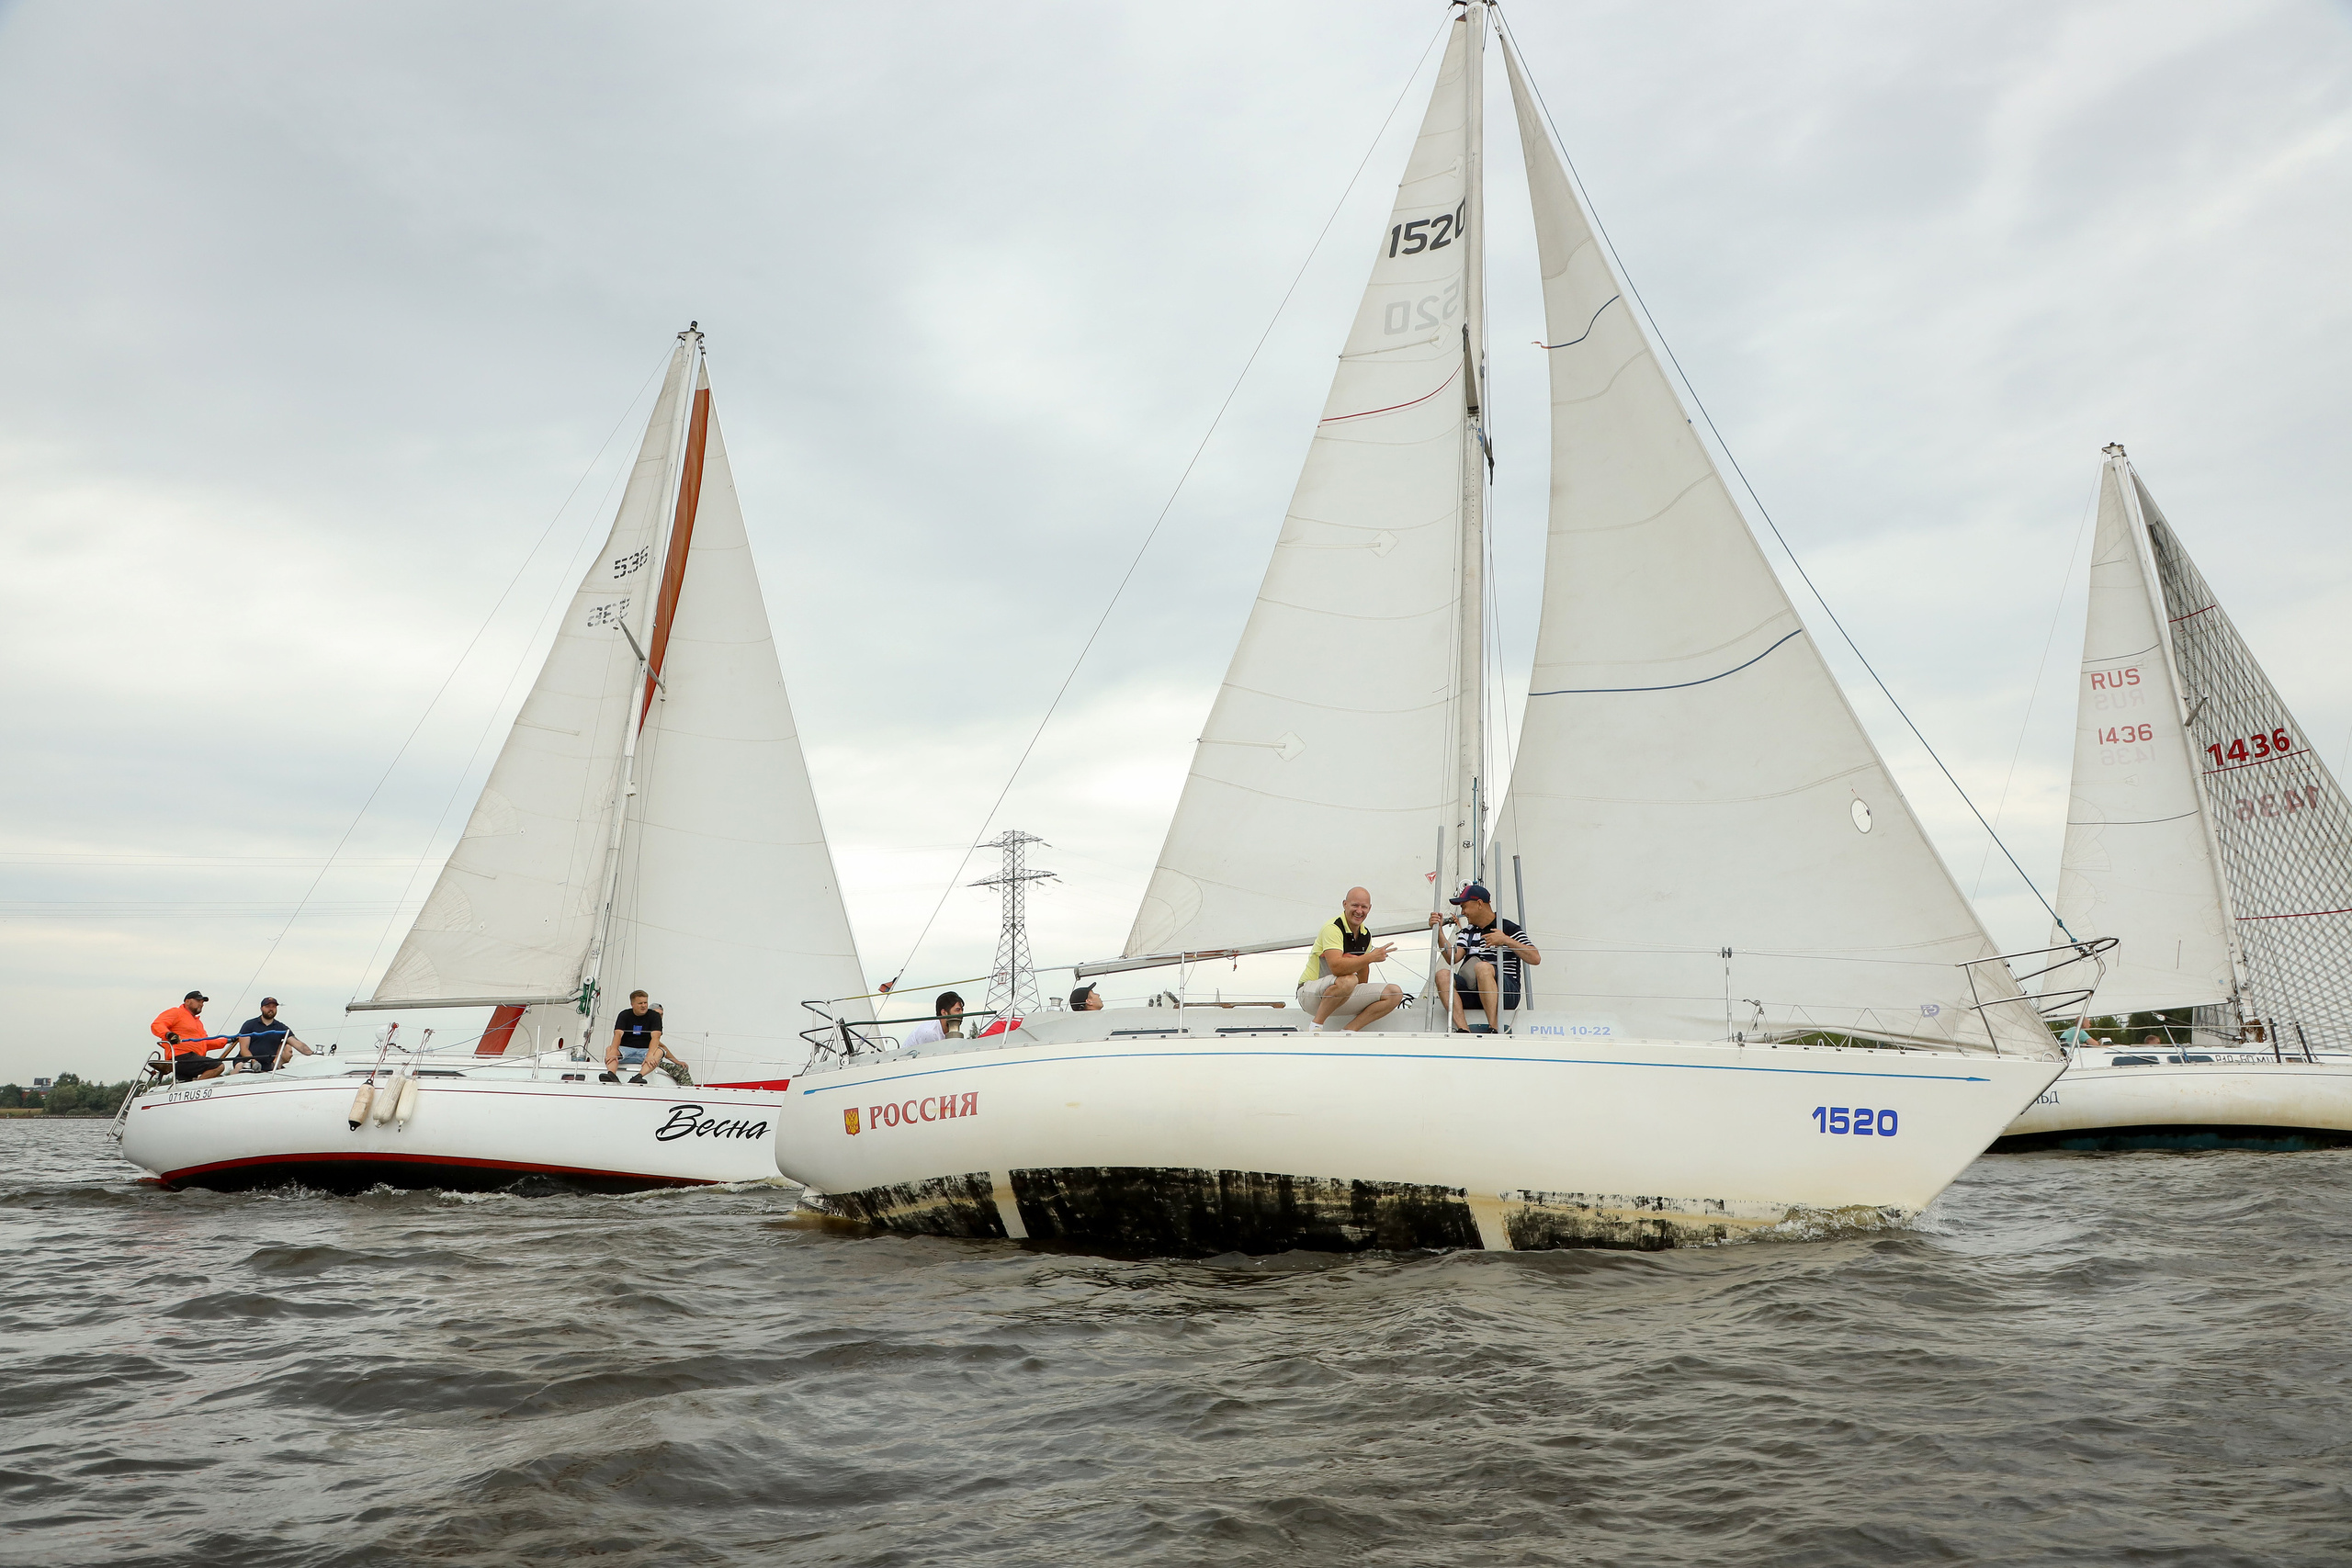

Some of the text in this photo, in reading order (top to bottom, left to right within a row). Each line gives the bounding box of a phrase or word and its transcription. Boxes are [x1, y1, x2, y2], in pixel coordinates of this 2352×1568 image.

[1389, 196, 1465, 258] 1520
[614, 546, 649, 579] 536
[2091, 669, 2141, 690] RUS
[2098, 724, 2154, 745] 1436
[2208, 728, 2290, 766] 1436
[1530, 1026, 1611, 1036] РМЦ 10-22
[169, 1089, 212, 1102] 071 RUS 50
[869, 1091, 978, 1129] РОССИЯ
[656, 1104, 771, 1141] Весна
[1812, 1106, 1898, 1136] 1520
